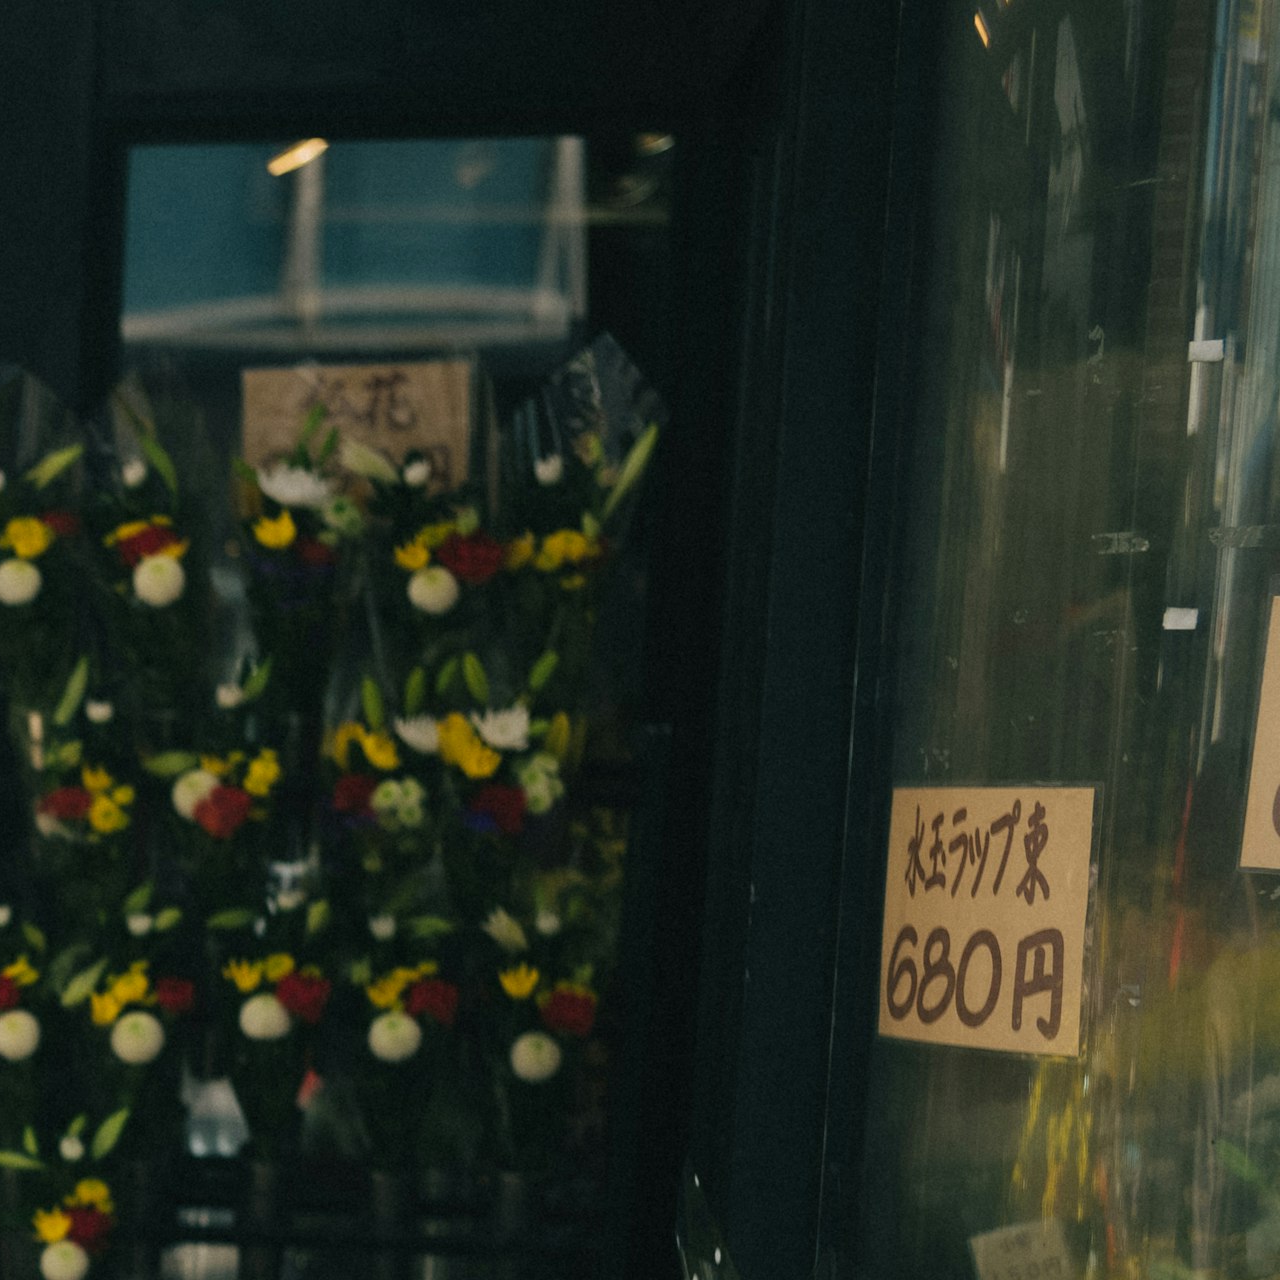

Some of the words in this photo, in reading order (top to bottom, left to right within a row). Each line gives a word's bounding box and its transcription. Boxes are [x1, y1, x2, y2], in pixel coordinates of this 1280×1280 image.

[904, 799, 1051, 906] 水玉ラップ束
[886, 923, 1065, 1041] 680円
